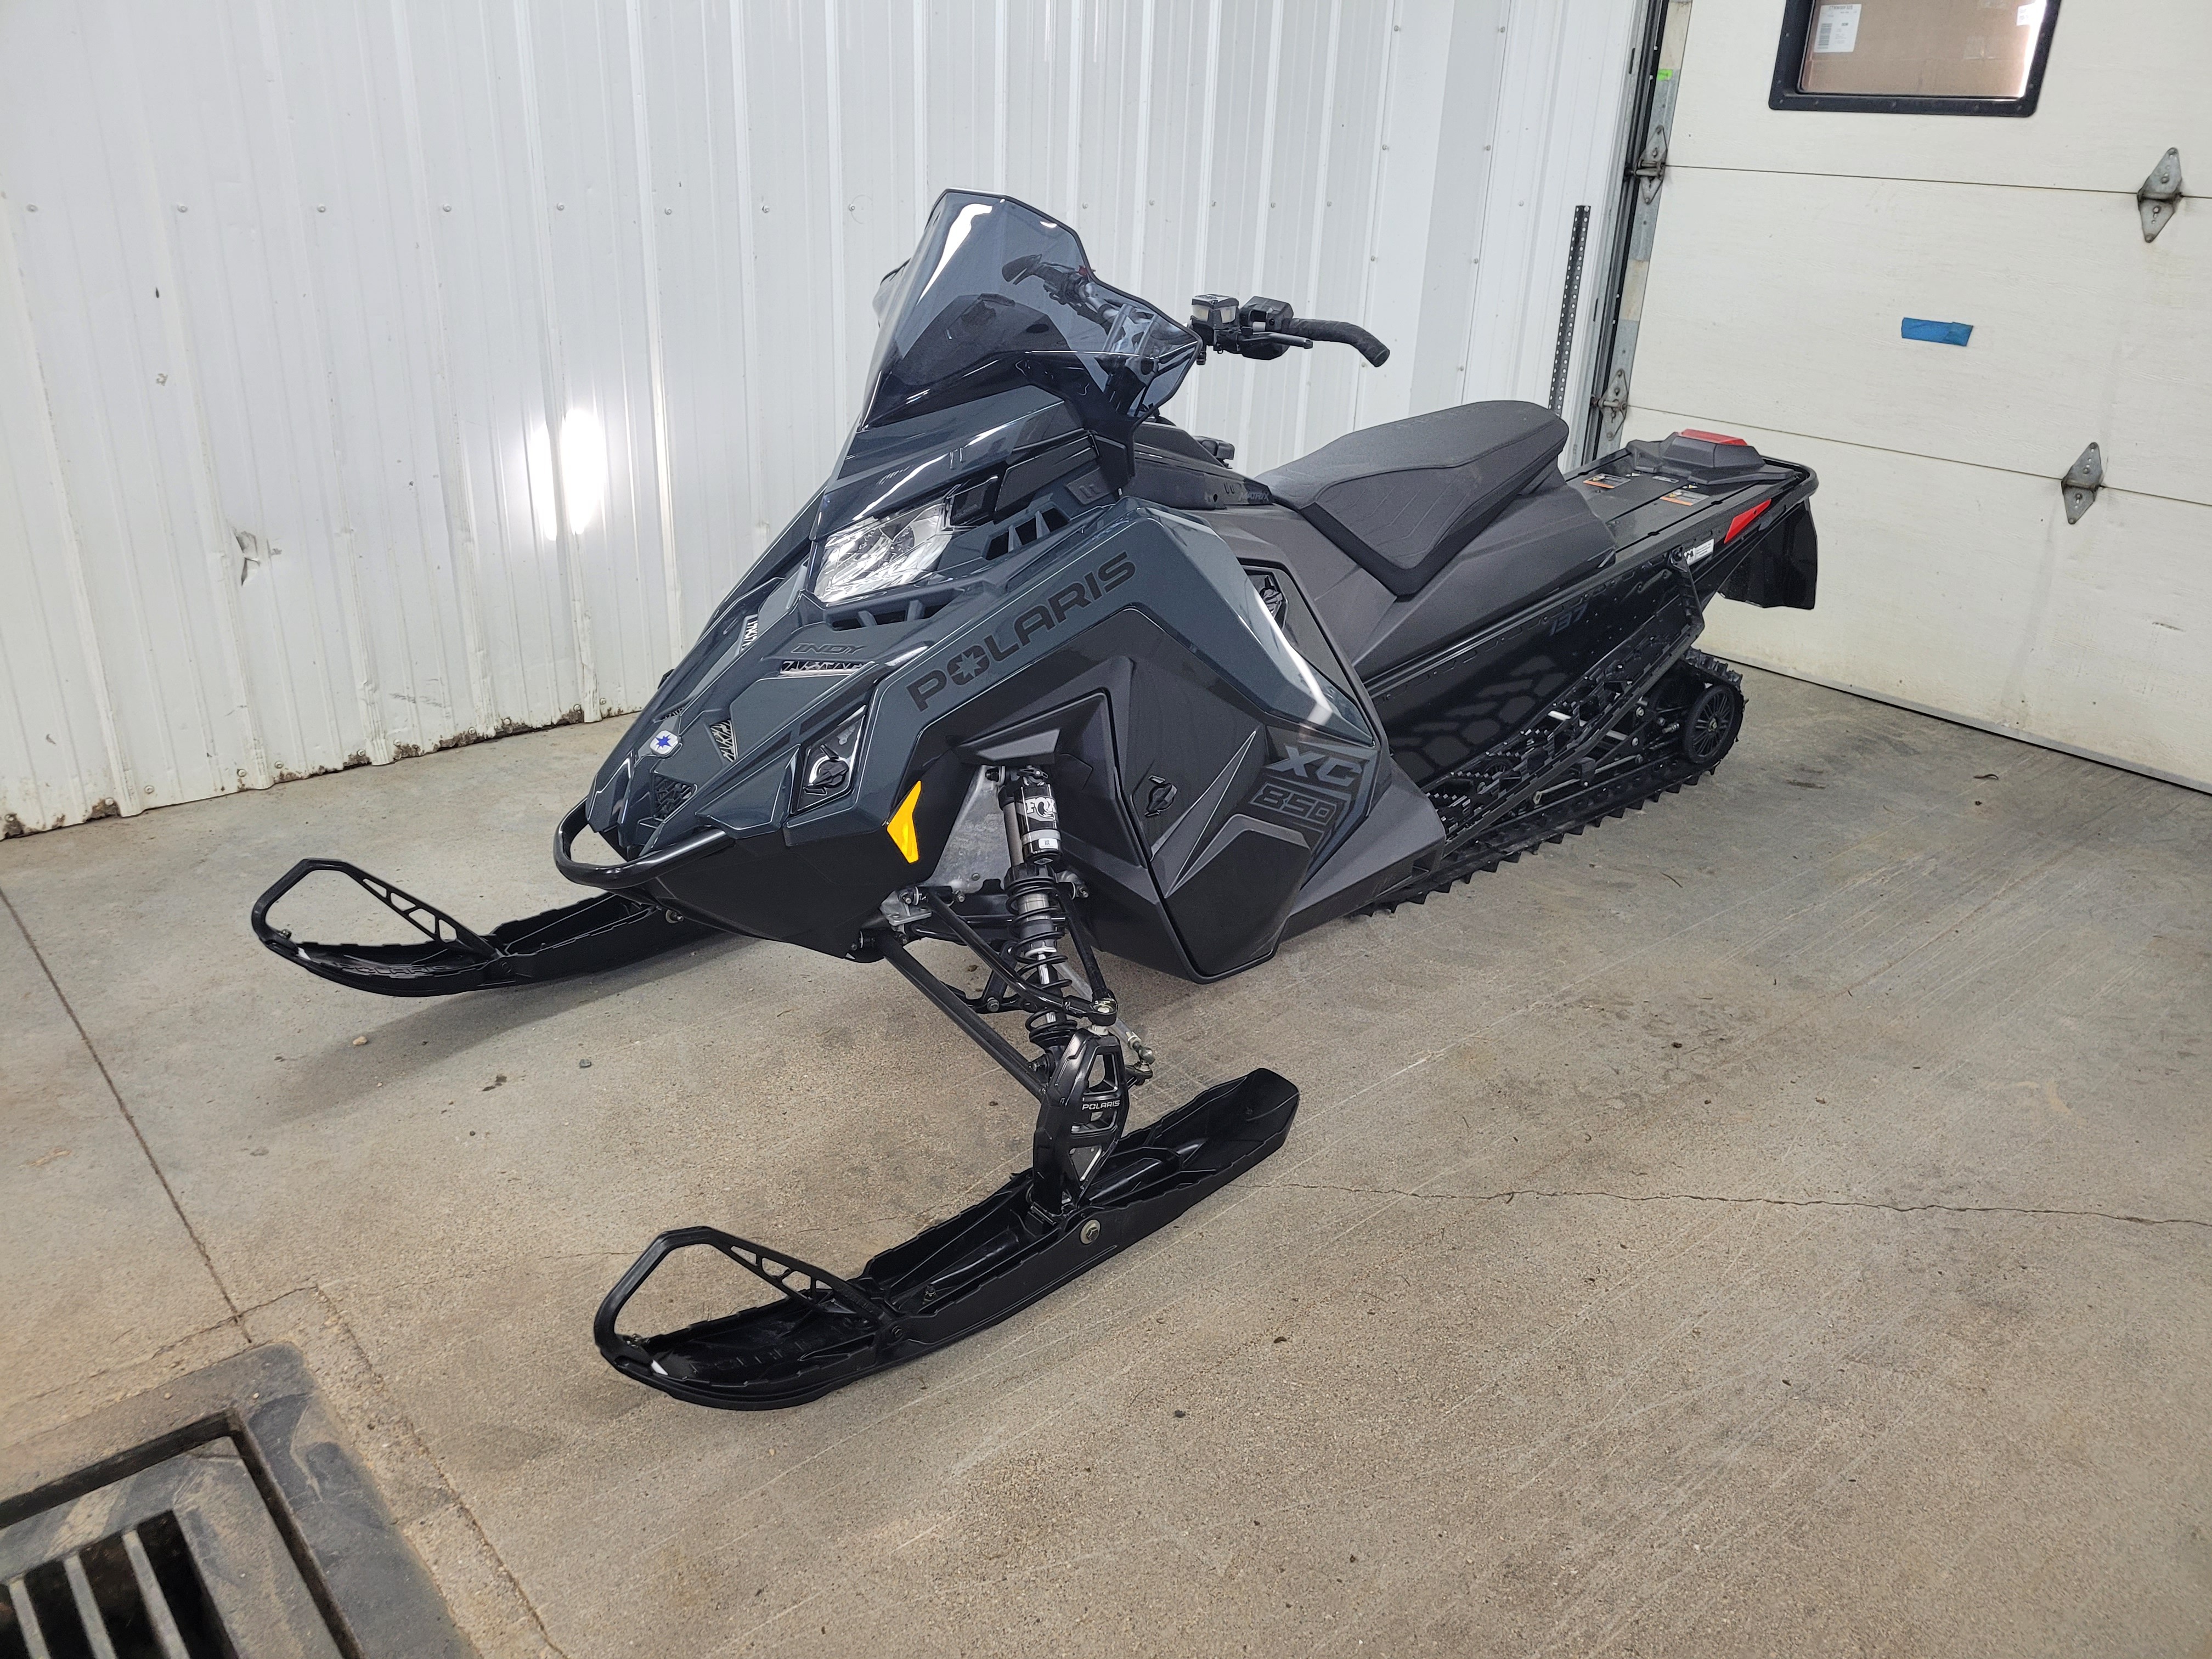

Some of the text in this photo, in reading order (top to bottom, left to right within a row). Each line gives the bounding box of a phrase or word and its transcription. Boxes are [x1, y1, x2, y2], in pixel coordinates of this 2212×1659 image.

[906, 551, 1136, 712] POLARIS
[1549, 602, 1589, 636] 137
[791, 643, 868, 654] INDY
[1265, 745, 1363, 787] XC
[1025, 797, 1057, 821] FOX
[1249, 782, 1337, 826] 850
[1082, 1100, 1120, 1110] POLARIS
